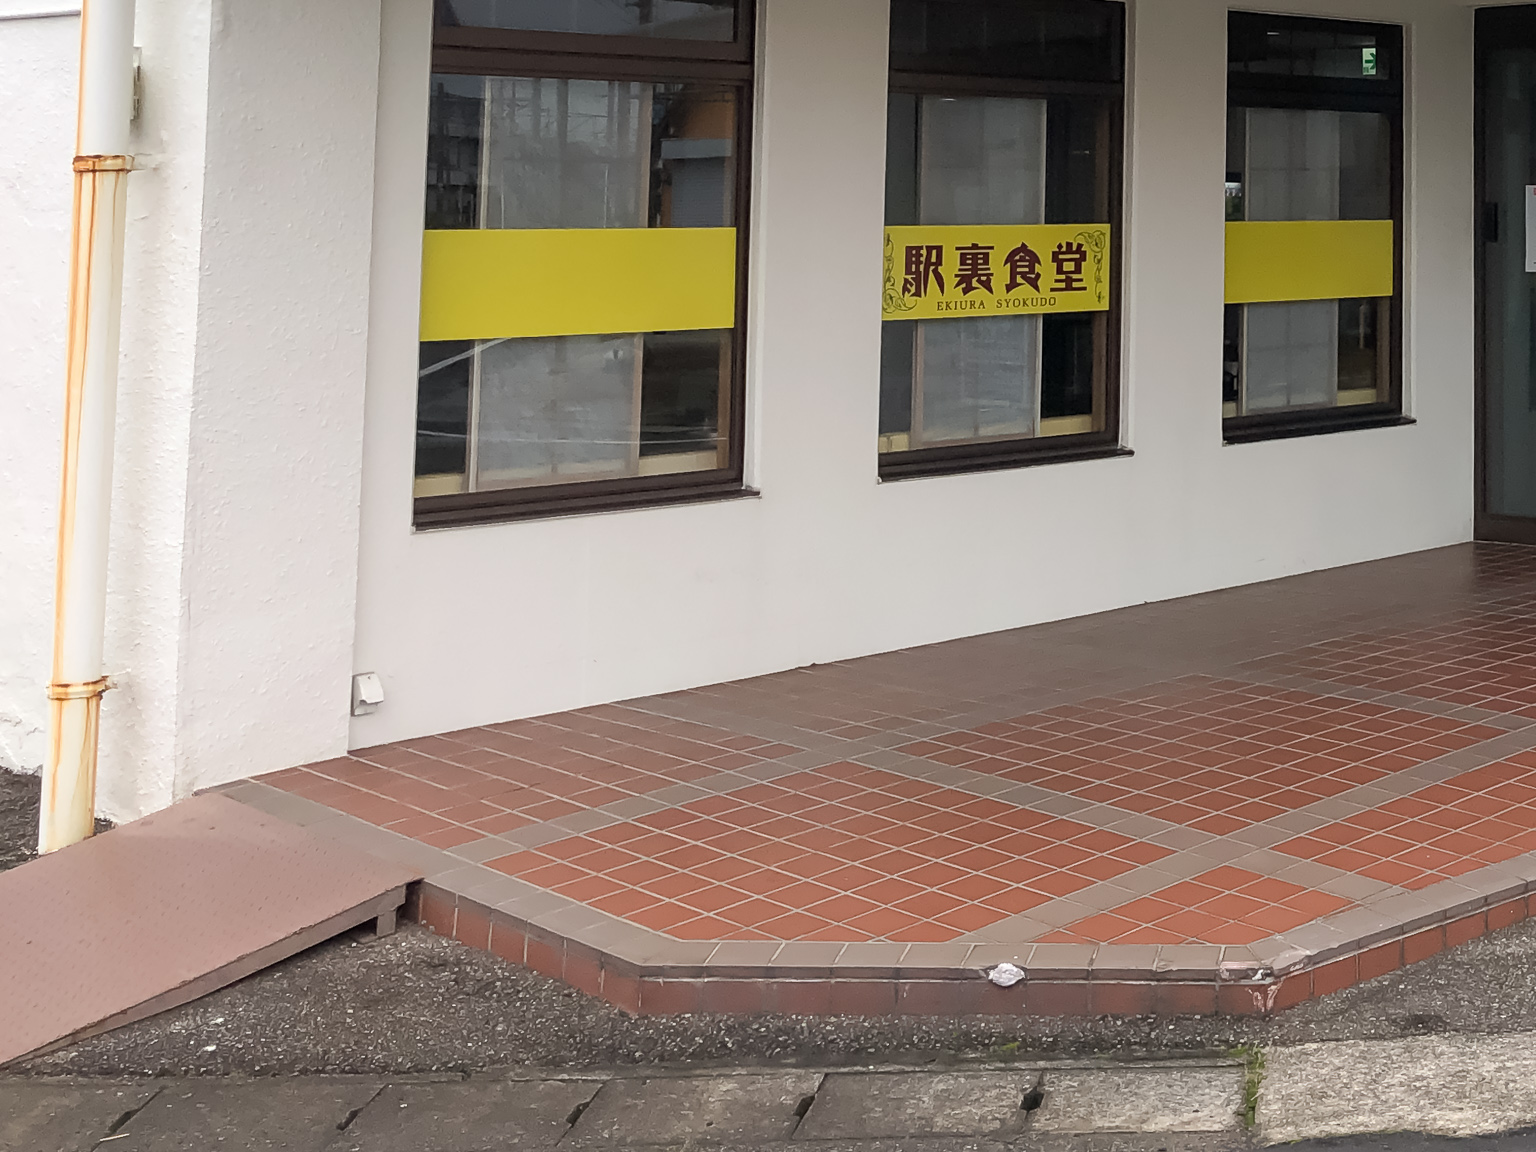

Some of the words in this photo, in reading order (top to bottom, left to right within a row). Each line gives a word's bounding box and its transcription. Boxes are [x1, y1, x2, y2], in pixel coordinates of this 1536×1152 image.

[901, 241, 1088, 299] 駅裏食堂
[936, 299, 986, 311] EKIURA
[996, 296, 1057, 309] SYOKUDO
